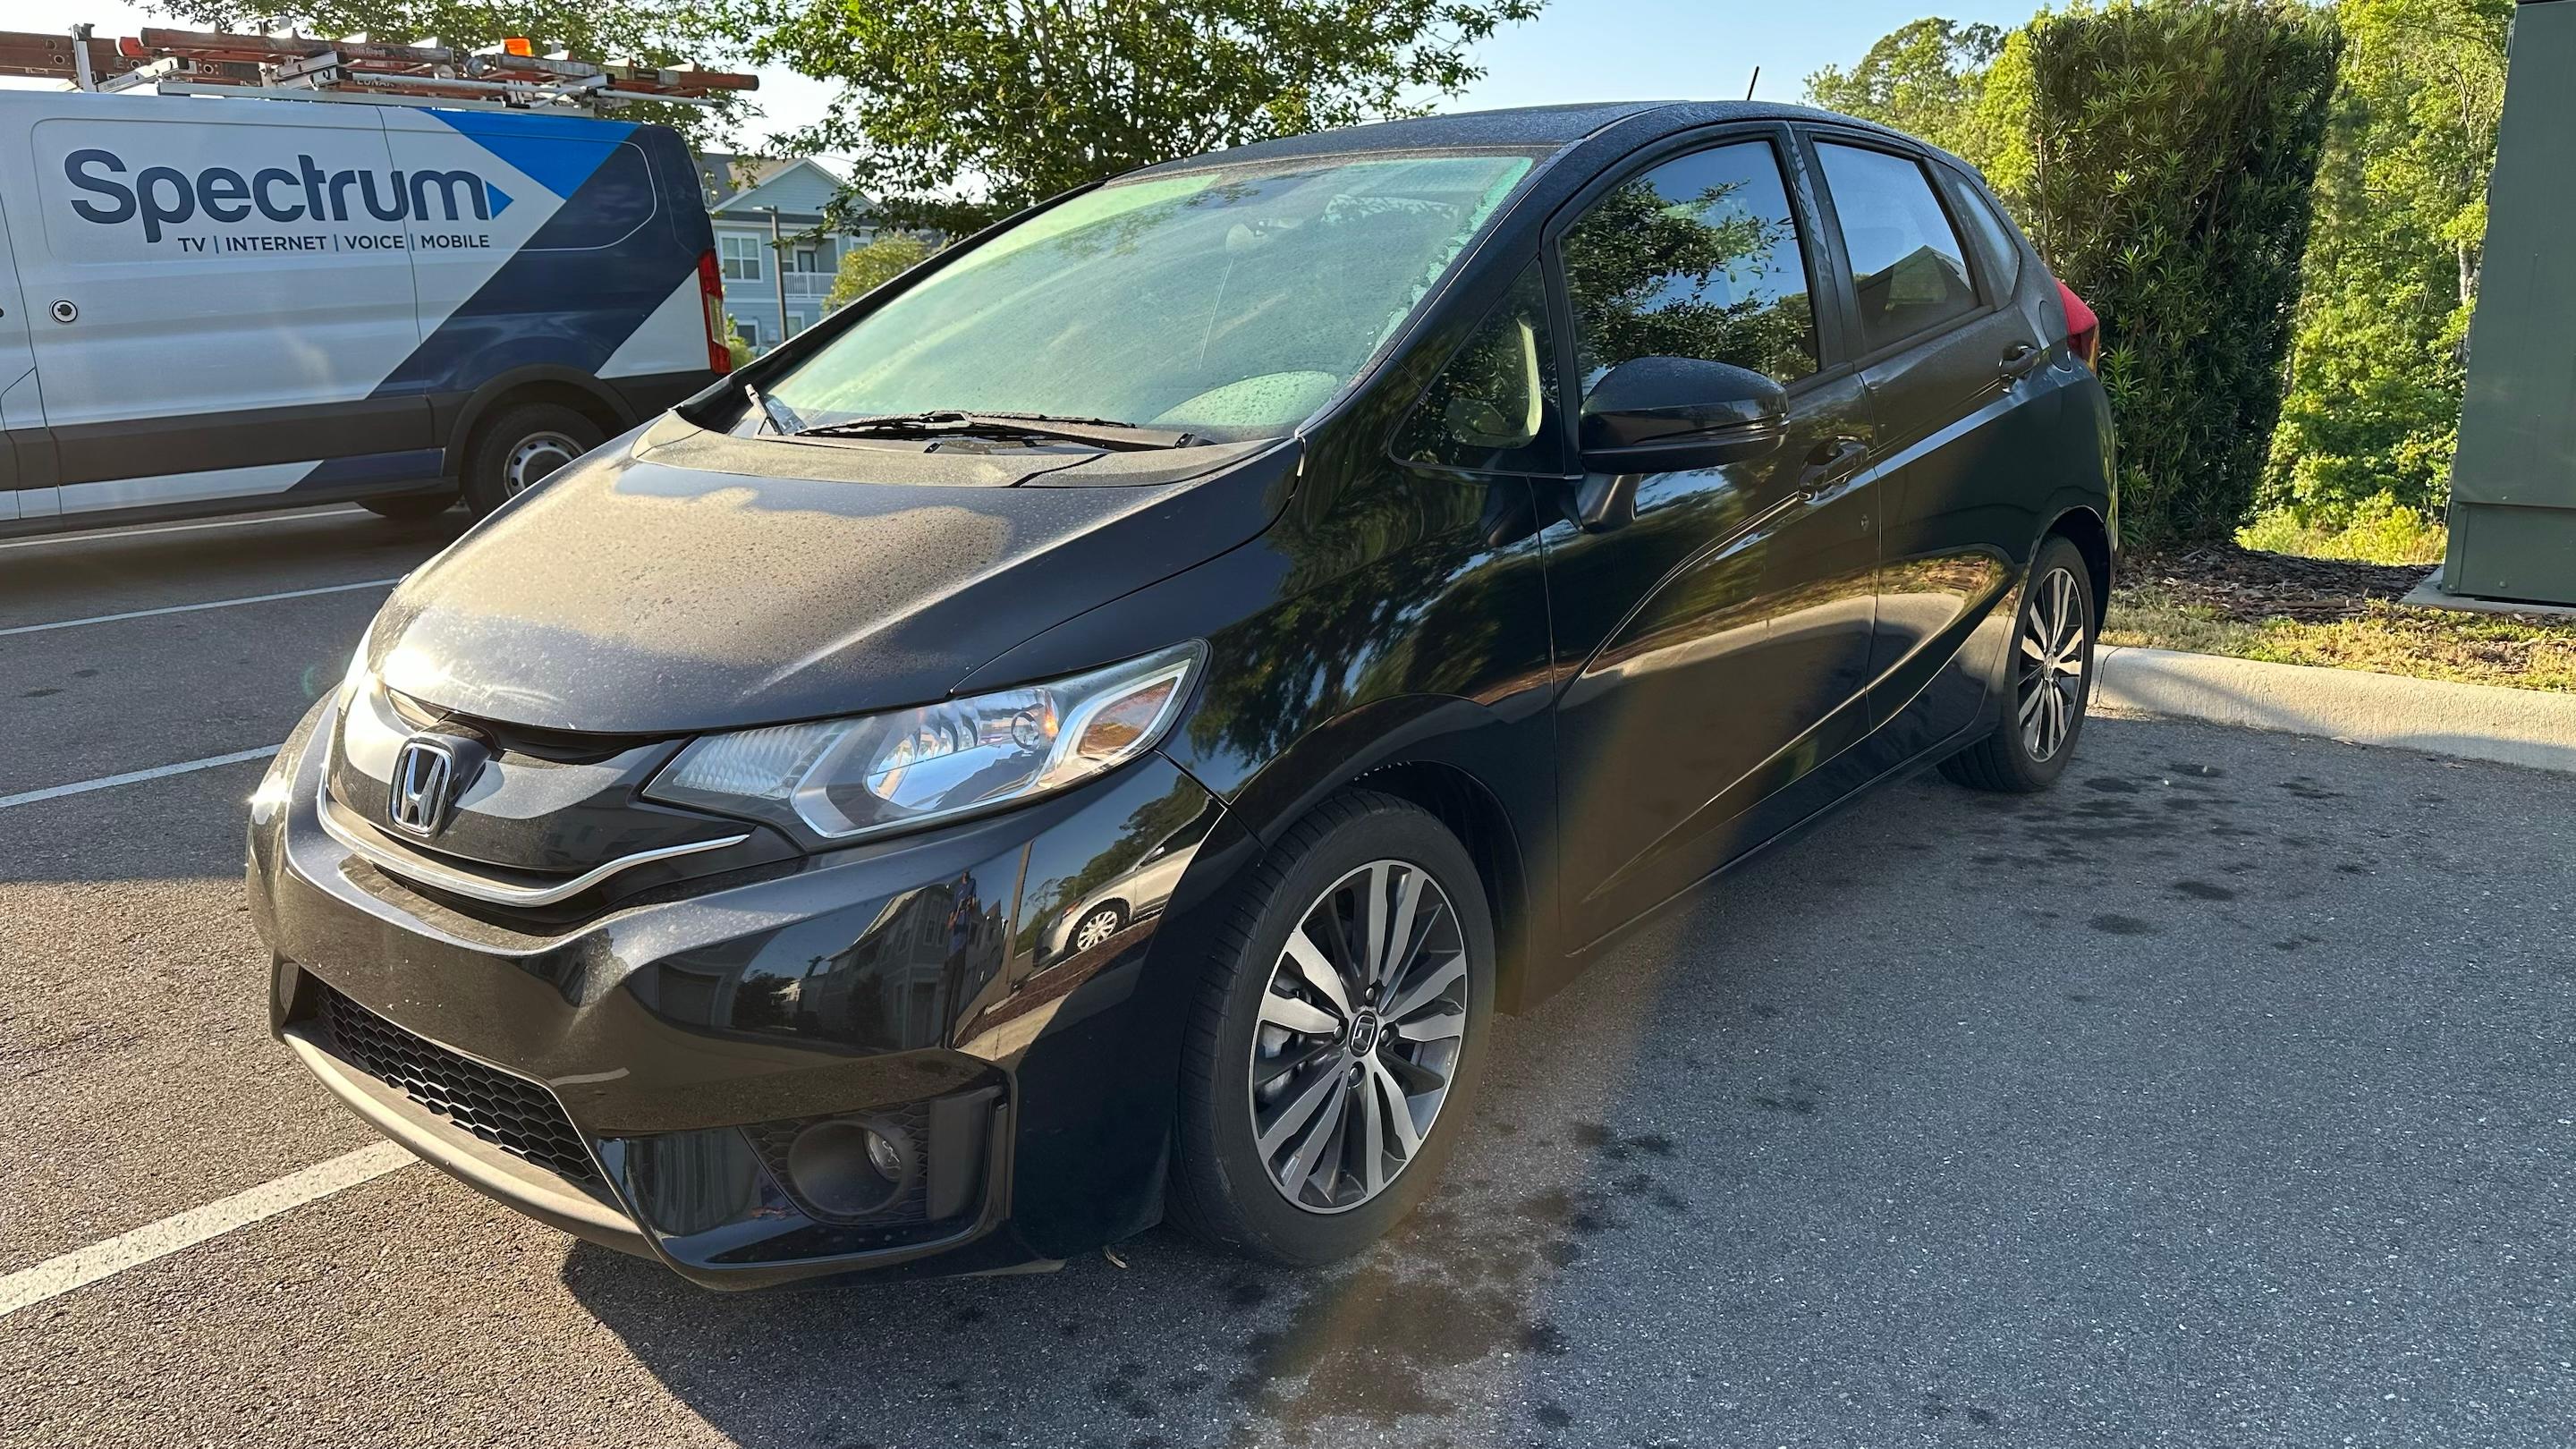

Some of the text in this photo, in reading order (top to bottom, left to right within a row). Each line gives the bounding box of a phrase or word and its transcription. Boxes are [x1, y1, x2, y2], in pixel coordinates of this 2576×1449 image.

[64, 148, 490, 243] Spectrum
[177, 234, 491, 253] TV INTERNET VOICE MOBILE
